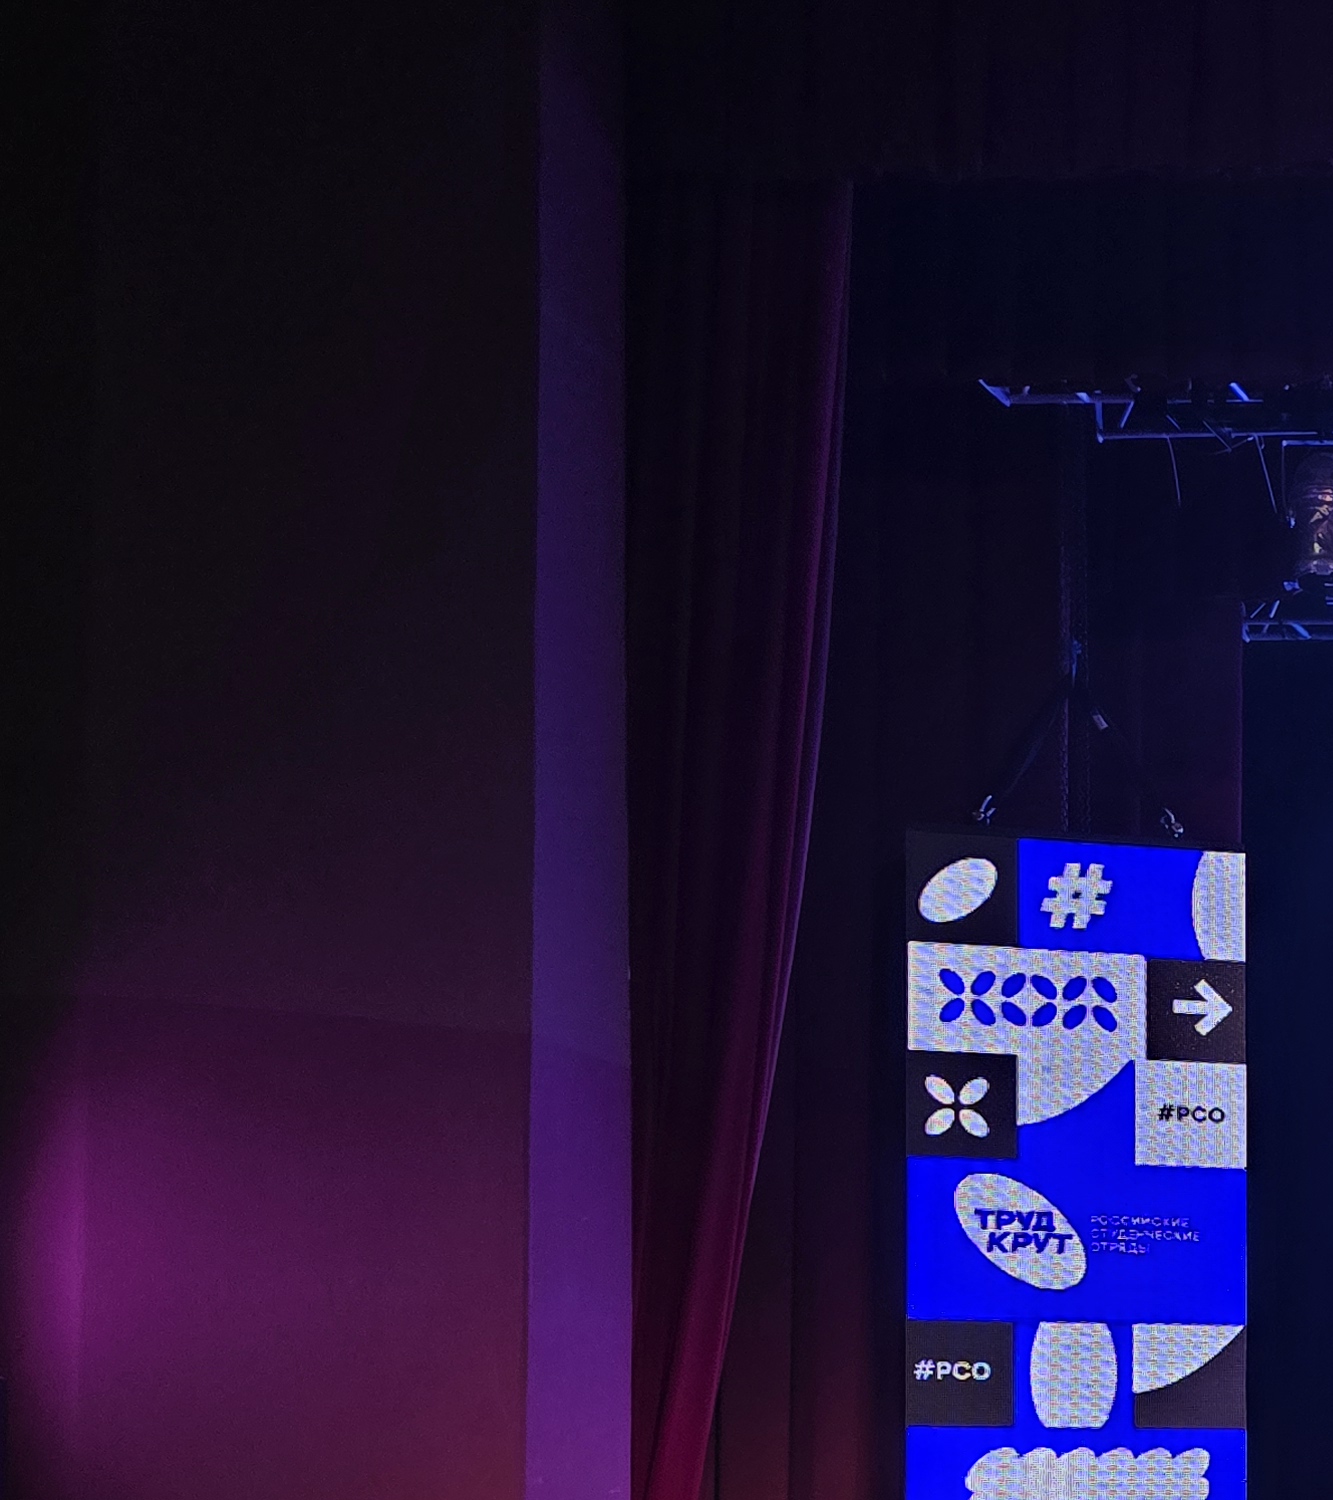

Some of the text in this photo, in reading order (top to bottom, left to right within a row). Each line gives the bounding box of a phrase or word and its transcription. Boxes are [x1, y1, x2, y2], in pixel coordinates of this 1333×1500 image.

[1158, 1103, 1225, 1123] #РСО
[974, 1208, 1056, 1232] ТРУД
[987, 1232, 1073, 1254] КРУТ
[913, 1359, 991, 1381] #РСО
